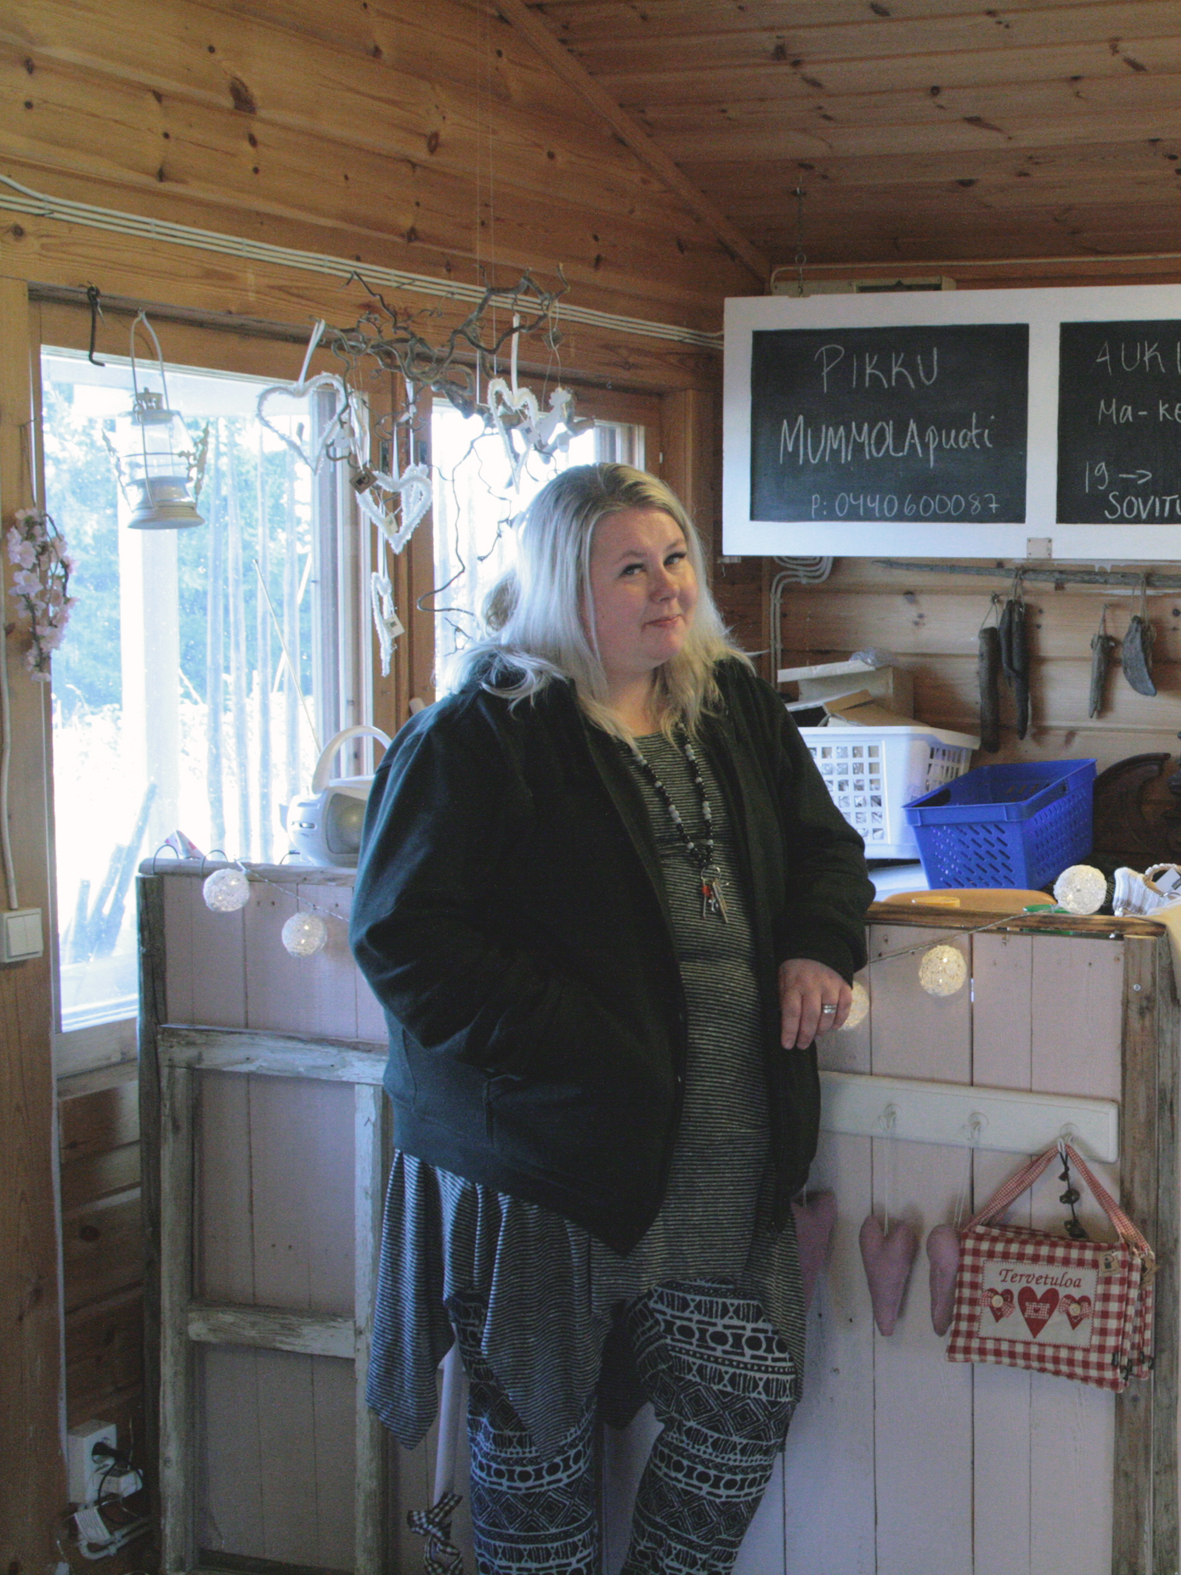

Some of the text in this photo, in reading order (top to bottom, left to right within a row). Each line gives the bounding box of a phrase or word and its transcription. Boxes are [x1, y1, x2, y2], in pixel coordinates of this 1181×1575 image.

[813, 343, 939, 393] PIKKU
[1095, 340, 1181, 376] AUKI
[1085, 460, 1110, 494] 19
[999, 1267, 1083, 1289] Tervetuloa
